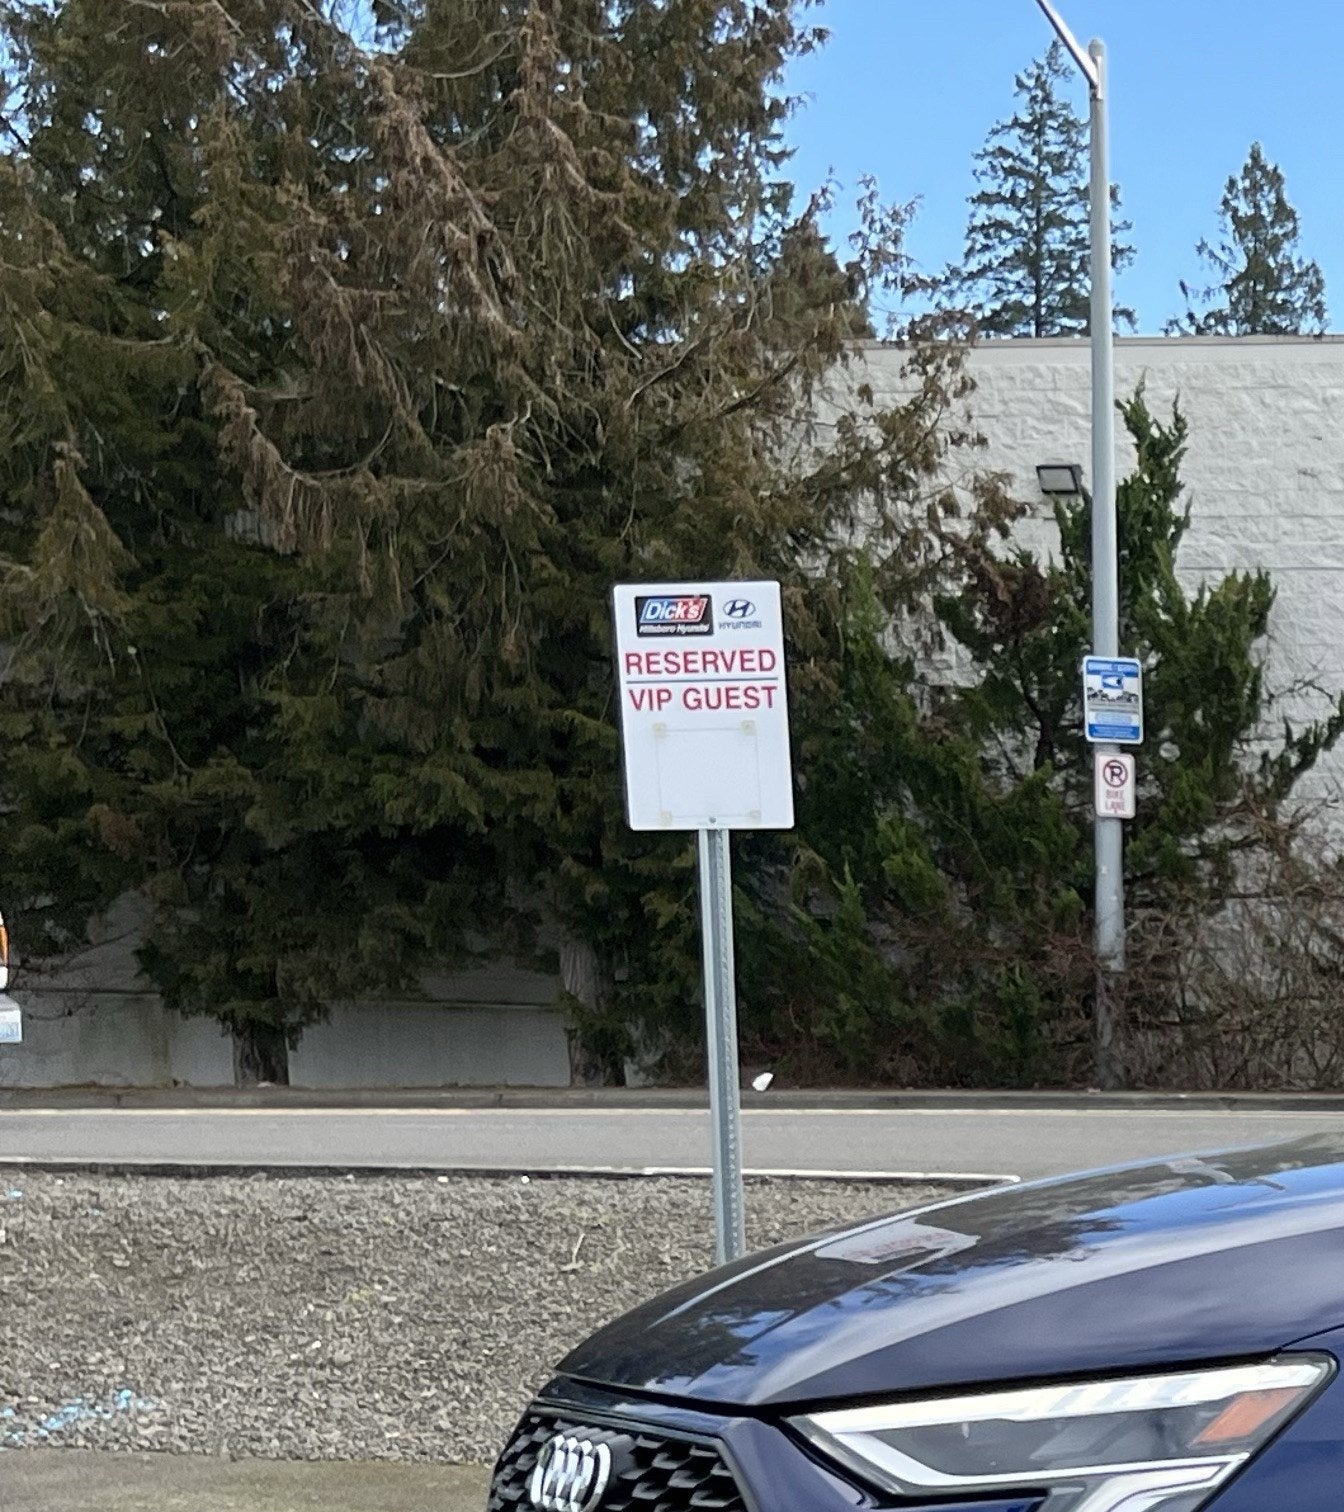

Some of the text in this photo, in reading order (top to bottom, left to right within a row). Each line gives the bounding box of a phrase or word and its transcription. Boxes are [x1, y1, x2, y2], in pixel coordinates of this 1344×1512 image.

[625, 649, 776, 675] RESERVED
[628, 685, 778, 711] VIP GUEST
